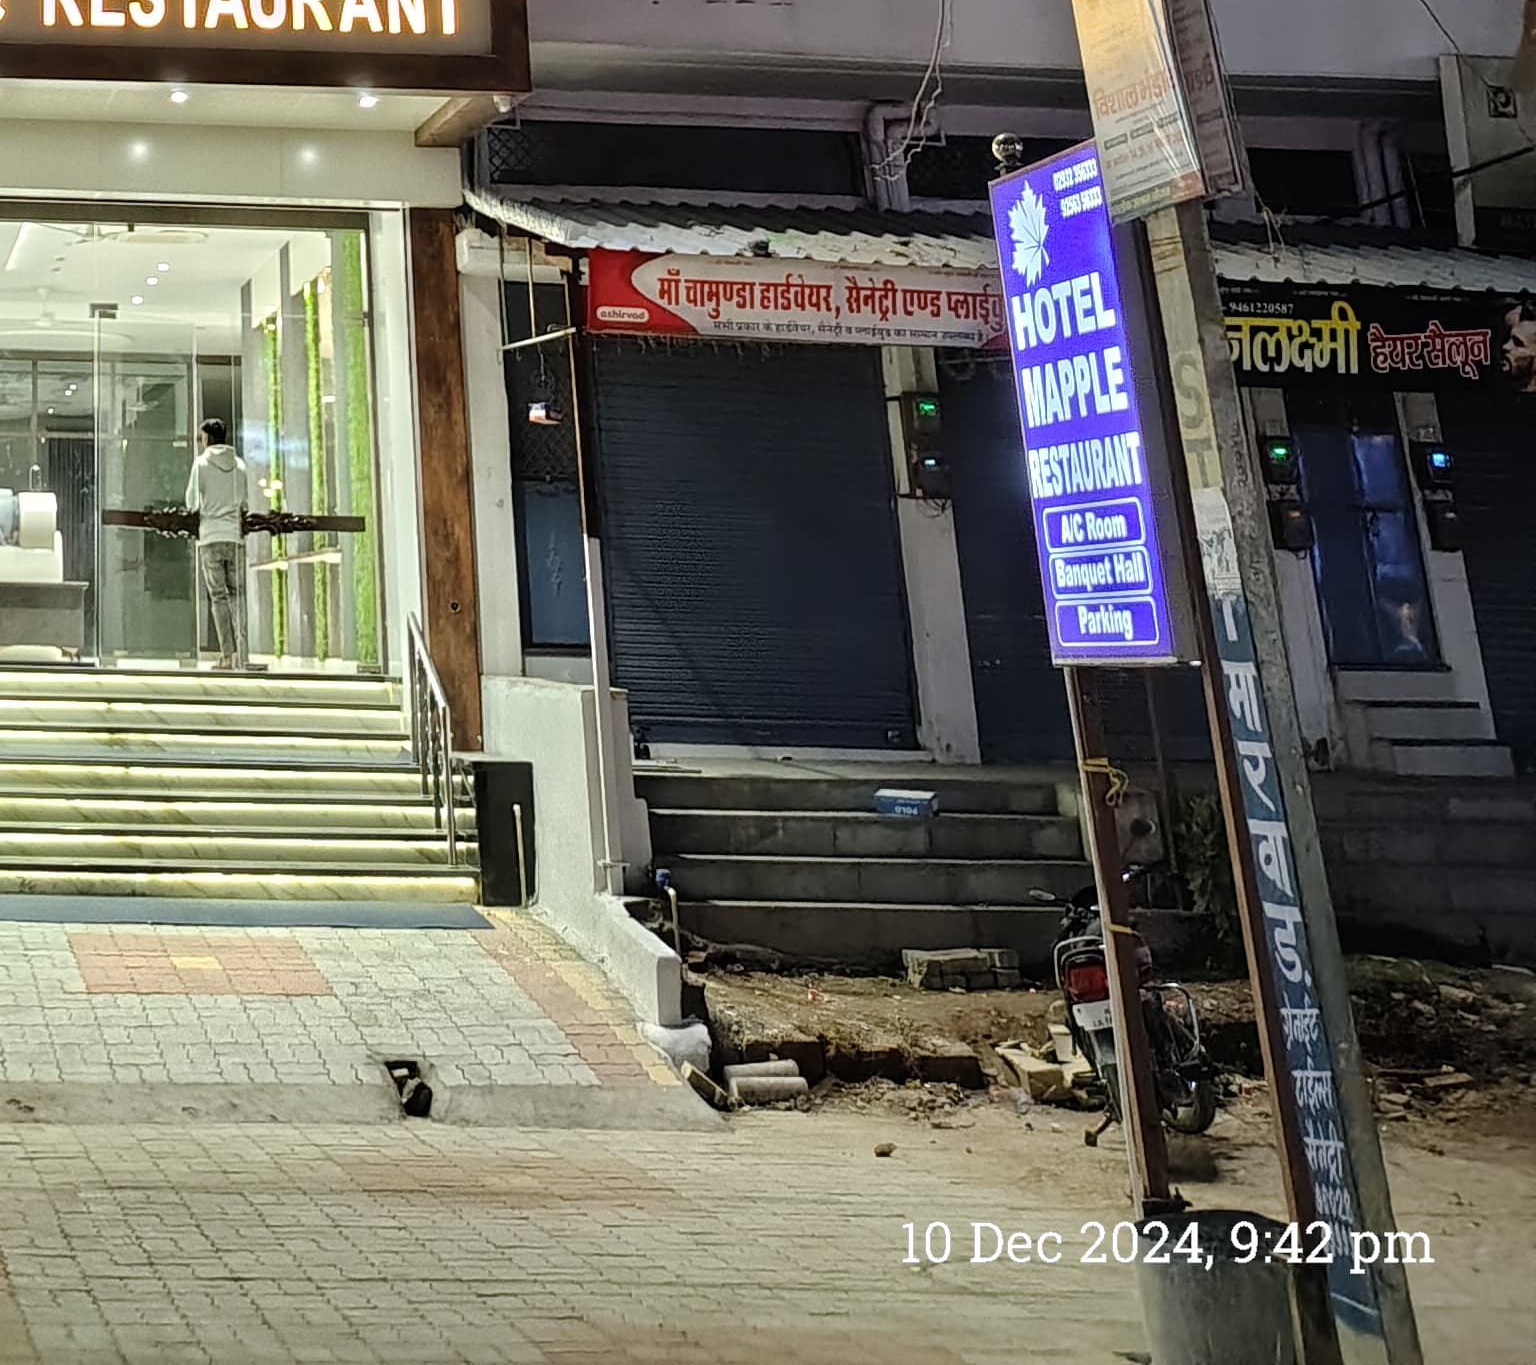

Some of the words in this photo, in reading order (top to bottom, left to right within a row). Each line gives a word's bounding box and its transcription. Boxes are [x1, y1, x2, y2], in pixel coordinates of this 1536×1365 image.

[600, 309, 645, 320] ashirvad
[657, 268, 681, 306] माँ
[684, 277, 757, 320] चामुण्डा
[759, 272, 841, 320] हार्डवेयर,
[845, 275, 898, 322] सैनेट्री
[901, 288, 942, 318] एण्ड
[1011, 271, 1116, 351] HOTEL
[1229, 301, 1294, 315] 9461220587
[1021, 345, 1129, 429] MAPPLE
[1028, 431, 1143, 500] RESTAURANT
[1061, 513, 1085, 544] A/C
[1085, 511, 1128, 542] Room
[1054, 555, 1113, 592] Banquet
[1113, 551, 1145, 585] Hall
[1077, 604, 1134, 641] Parking
